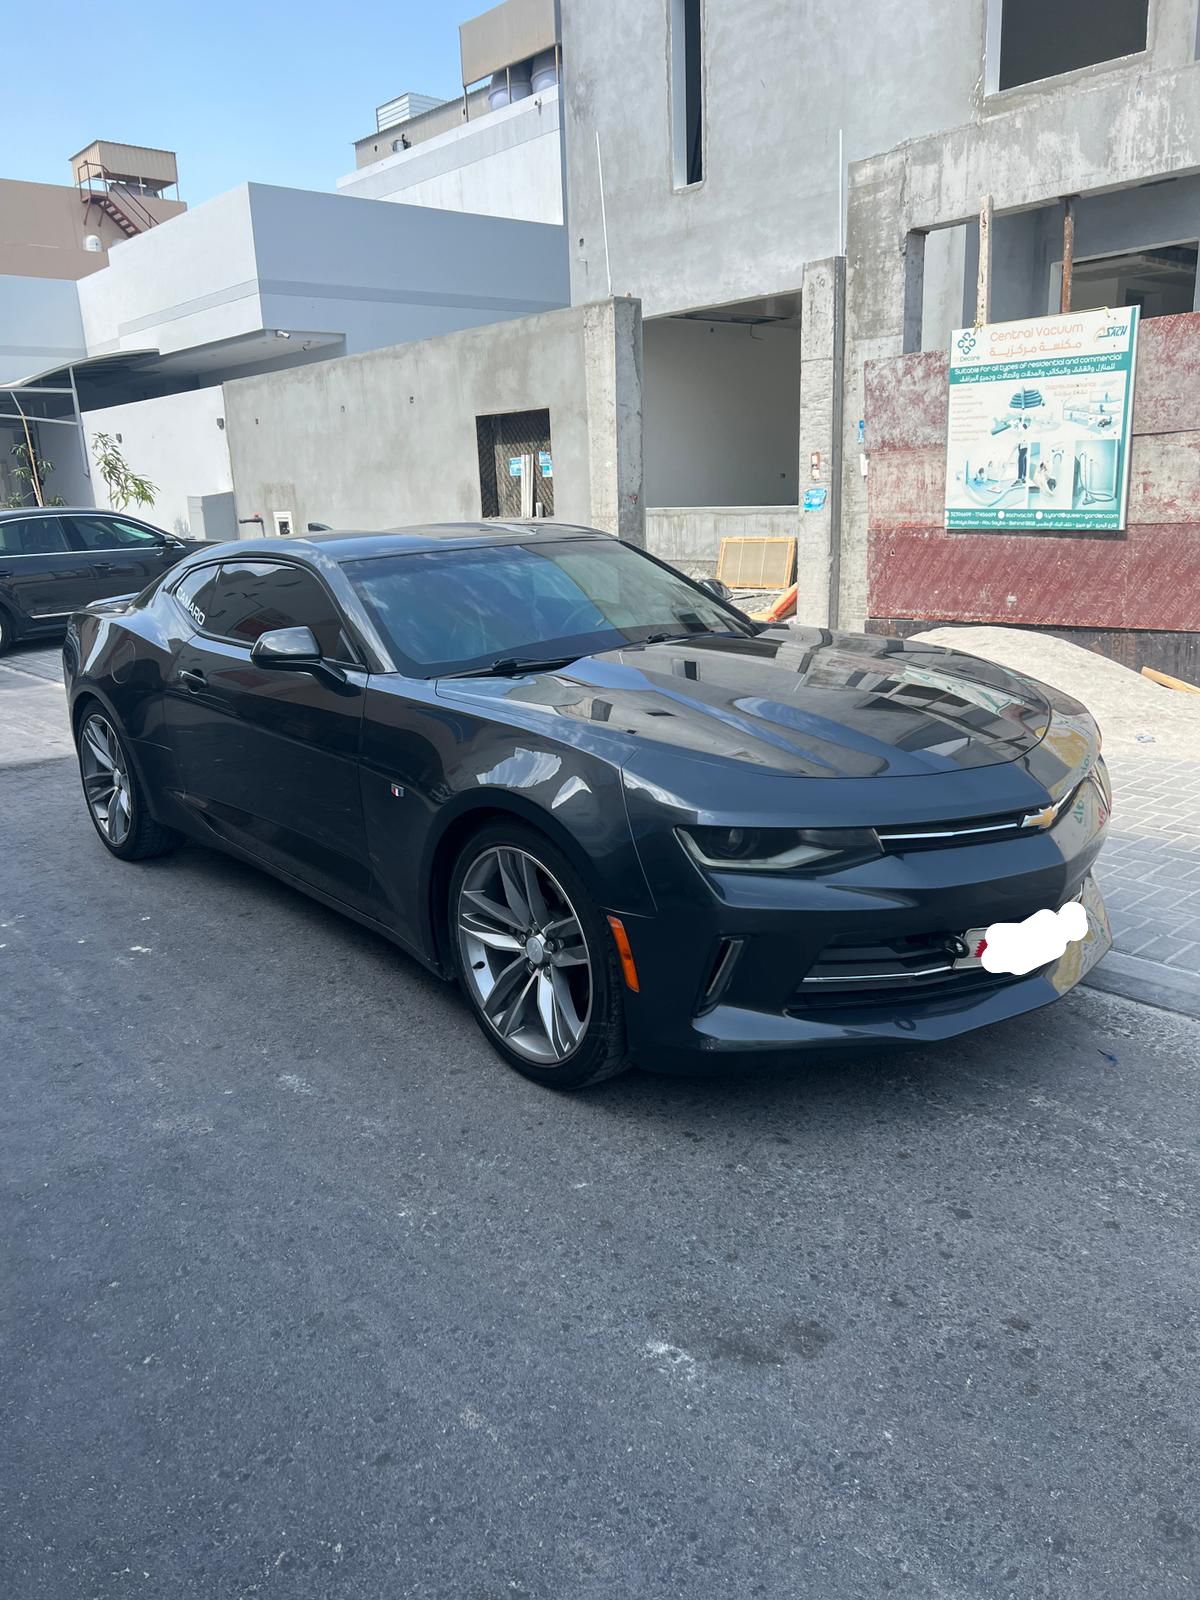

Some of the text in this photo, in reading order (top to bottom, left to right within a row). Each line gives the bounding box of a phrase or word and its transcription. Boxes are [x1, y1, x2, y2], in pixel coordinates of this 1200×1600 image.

[990, 324, 1084, 342] Central Vacuum
[989, 339, 1082, 358] مكنسة مركزية
[954, 353, 1122, 376] Suitable for all types of residential and commercial
[176, 586, 206, 626] CAMARO
